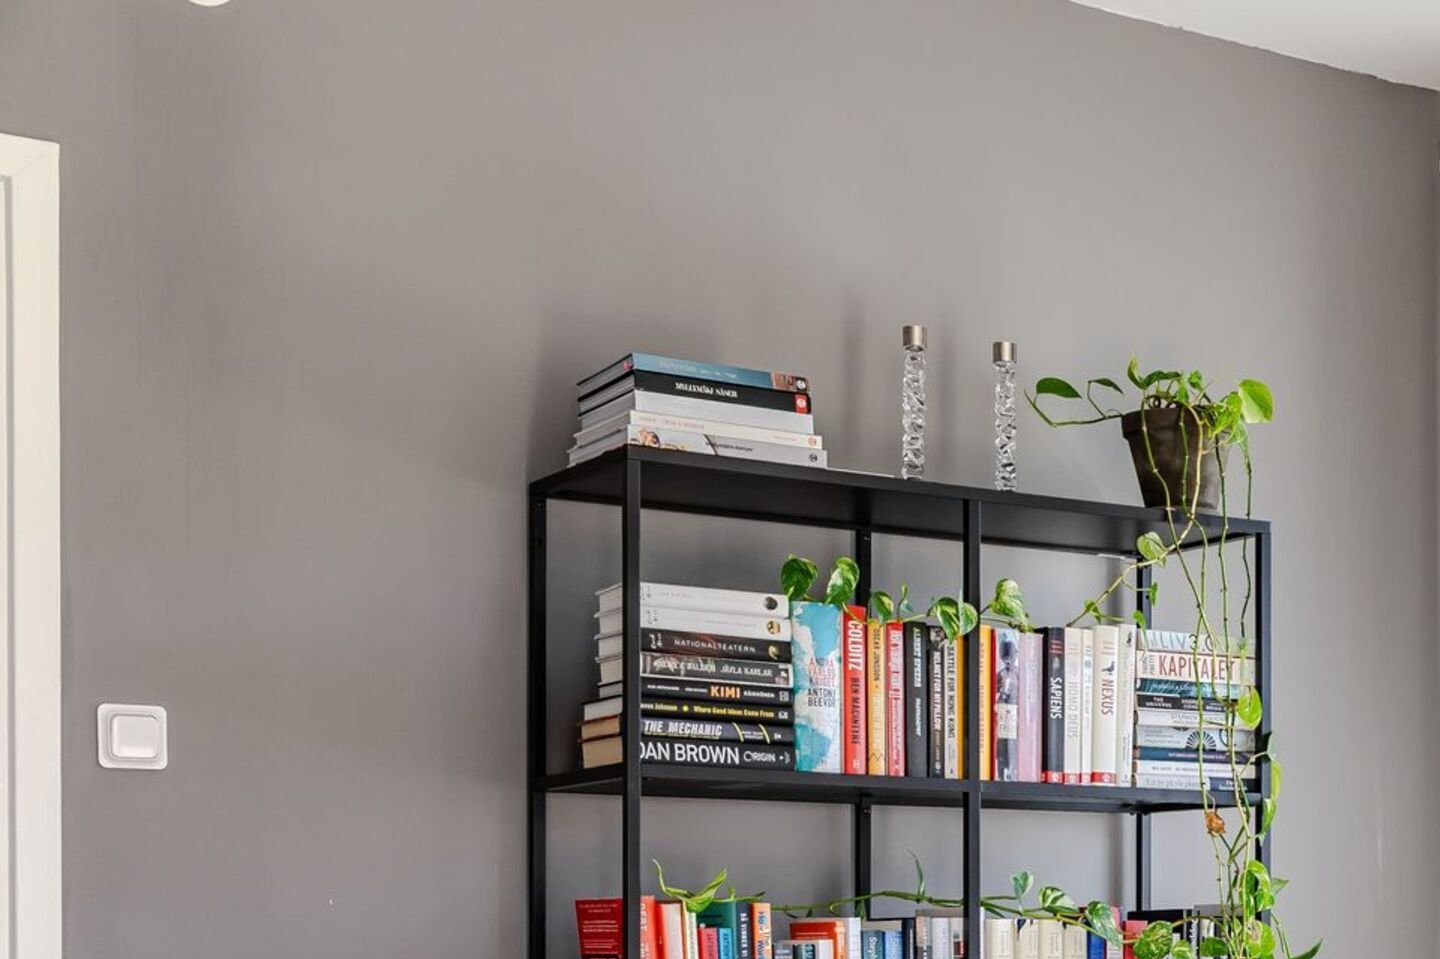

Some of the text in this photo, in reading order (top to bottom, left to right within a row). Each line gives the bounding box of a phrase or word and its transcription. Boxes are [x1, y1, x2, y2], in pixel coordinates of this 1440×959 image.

[674, 639, 757, 653] NATIONALTEATERN
[848, 620, 863, 672] COLDITZ
[710, 685, 741, 699] KIMI
[851, 677, 861, 694] BEN
[933, 679, 942, 692] FOR
[946, 677, 955, 692] FOR
[1049, 677, 1062, 719] SAPIENS
[1101, 679, 1115, 715] NEXUS
[644, 720, 663, 733] THE
[668, 722, 723, 737] MECHANIC
[946, 718, 955, 739] KONG
[673, 743, 741, 765] BROWN
[743, 751, 776, 762] ORIGIN
[740, 923, 749, 948] VINNER
[741, 949, 749, 957] VI
